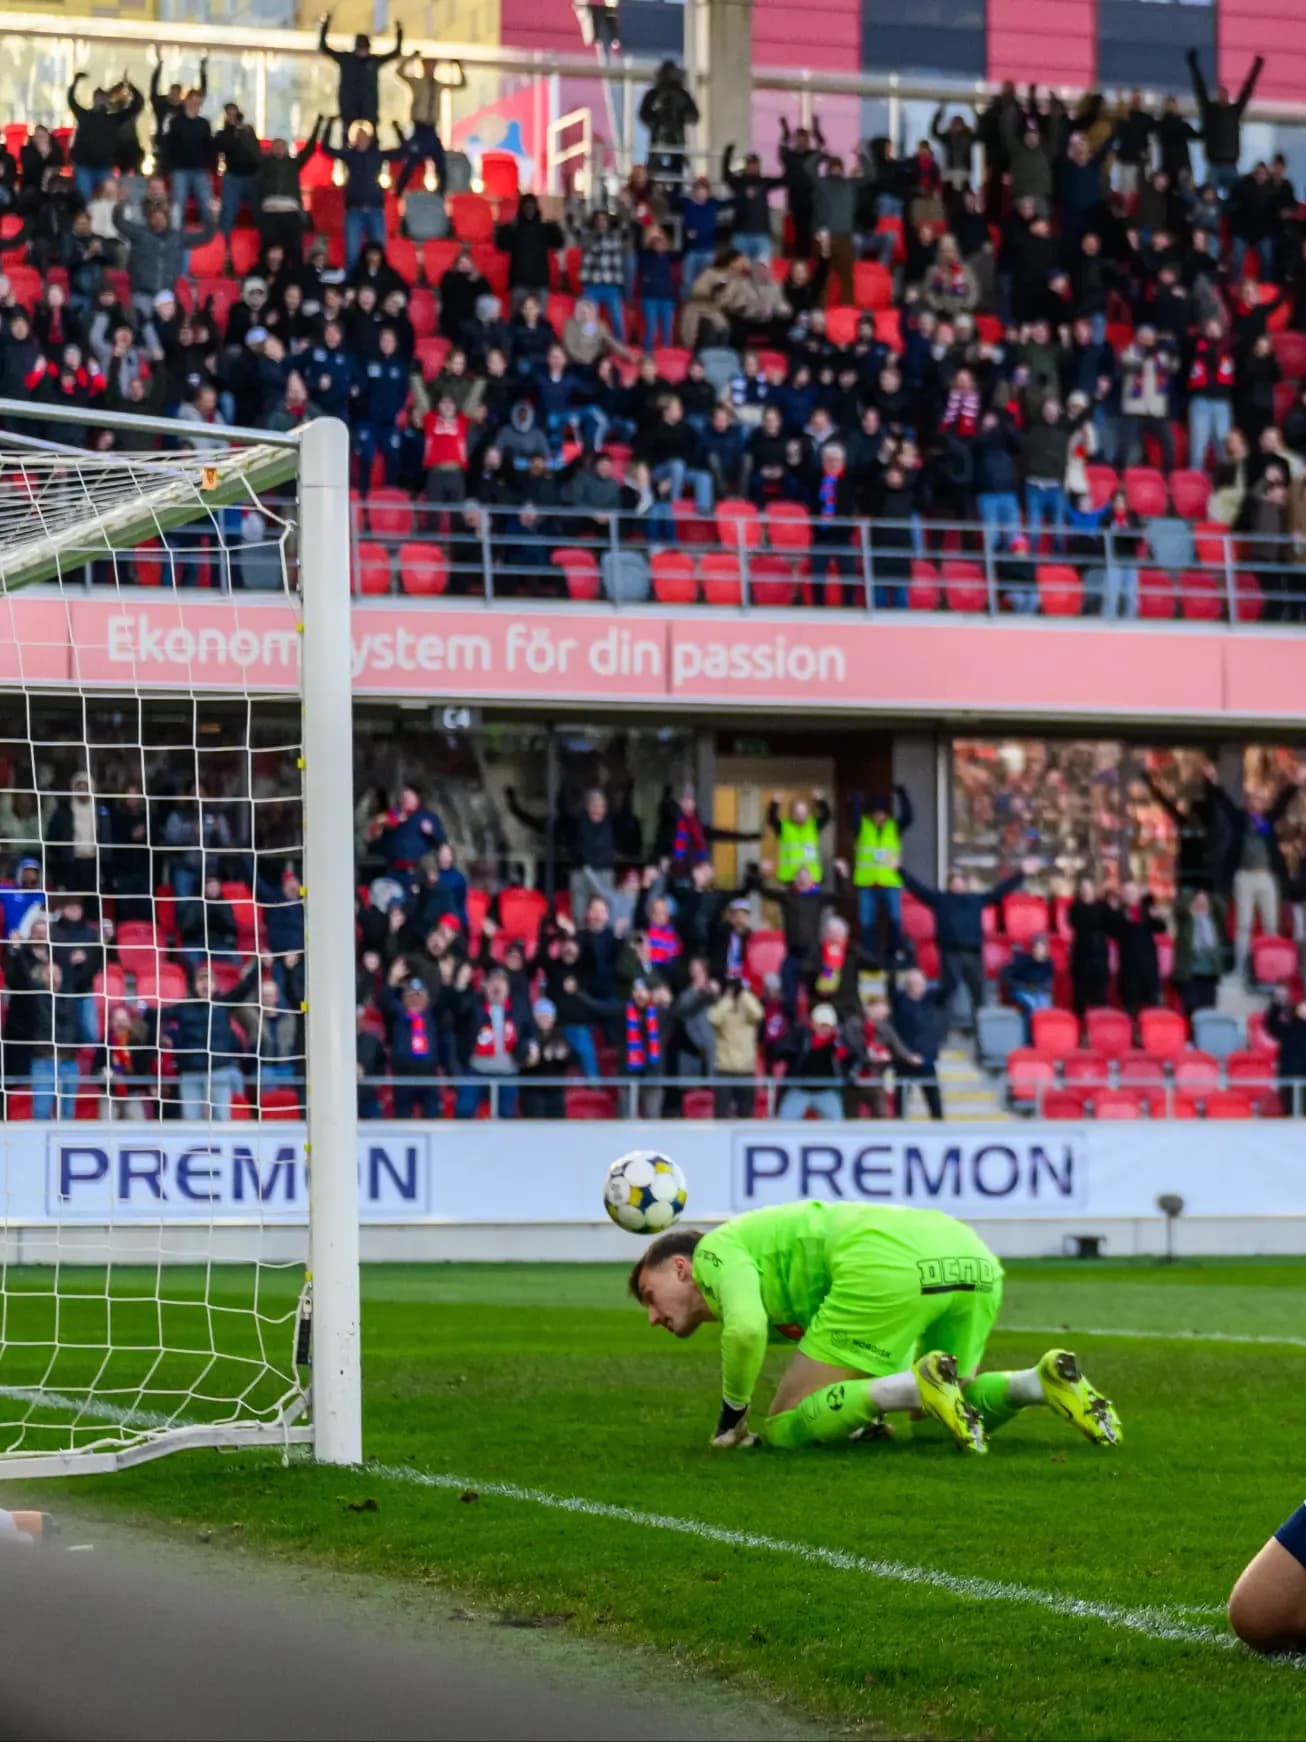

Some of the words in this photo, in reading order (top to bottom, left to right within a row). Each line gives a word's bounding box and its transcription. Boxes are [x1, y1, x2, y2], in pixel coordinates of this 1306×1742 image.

[506, 623, 578, 674] för
[589, 626, 661, 676] din
[673, 636, 845, 686] passion
[59, 1146, 417, 1202] PREMN
[744, 1145, 1074, 1198] PREMON
